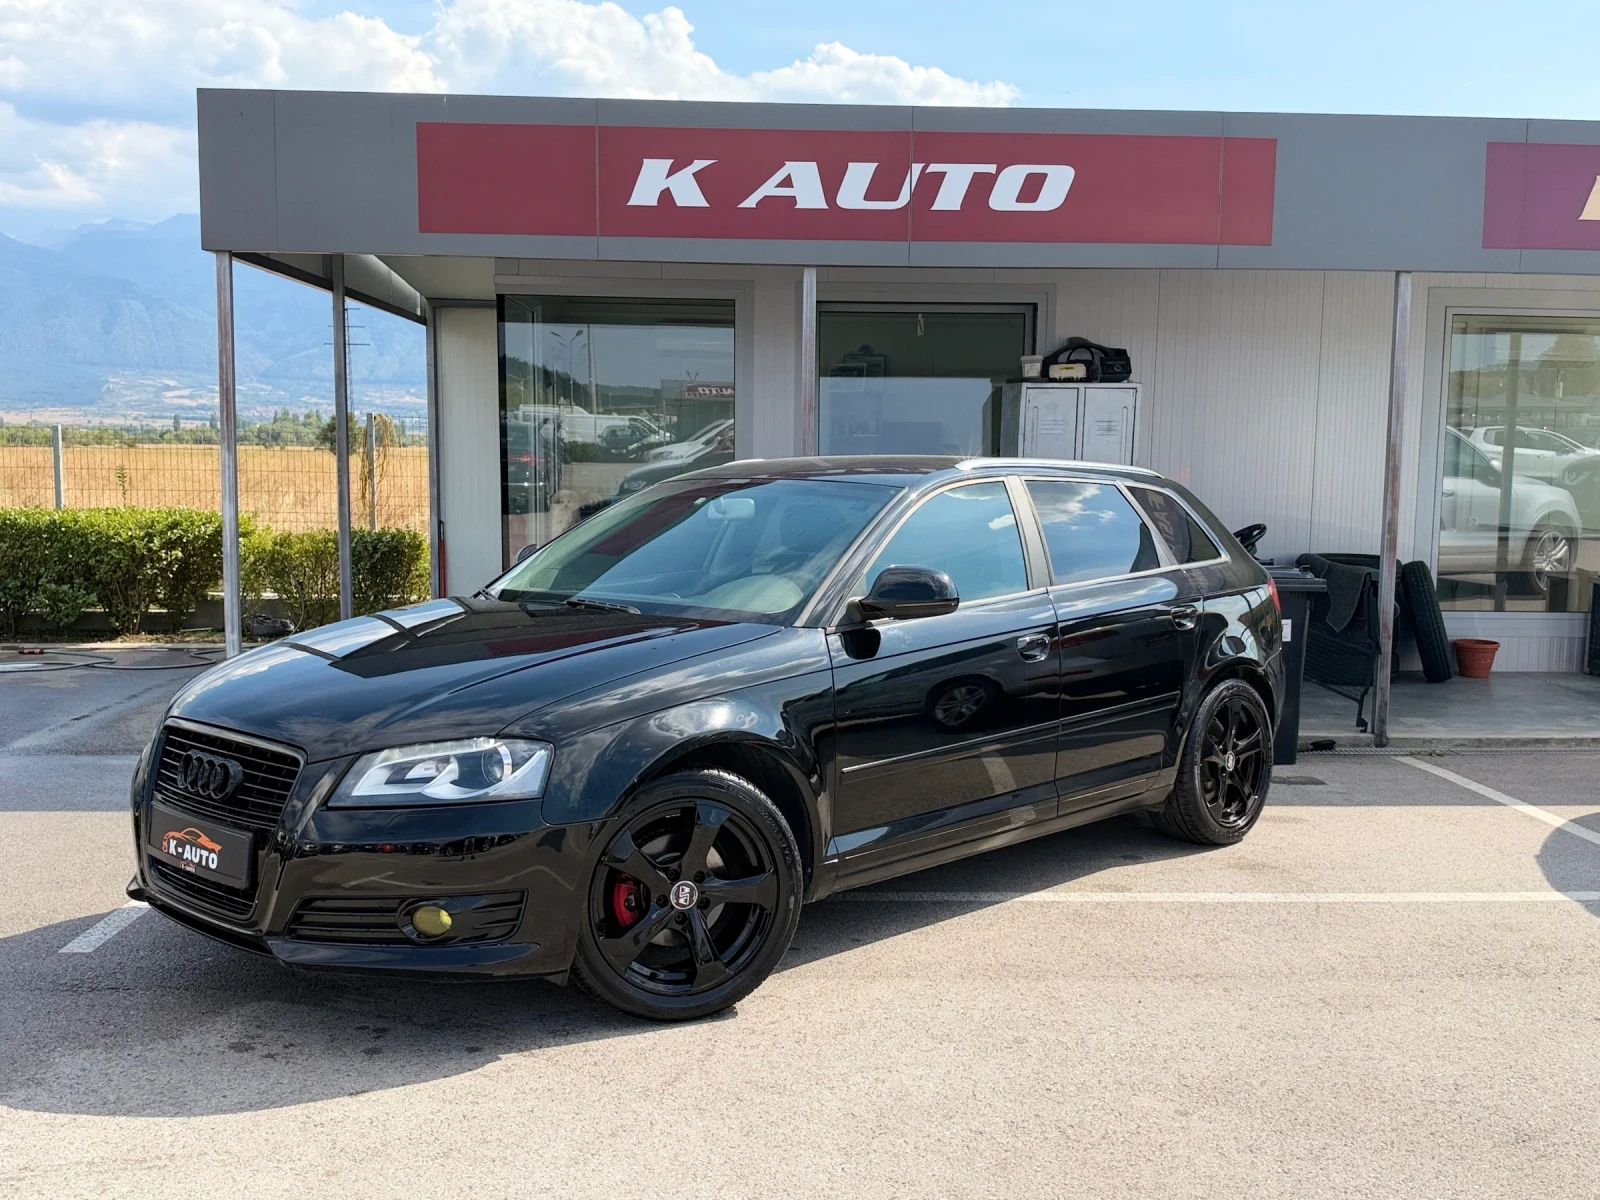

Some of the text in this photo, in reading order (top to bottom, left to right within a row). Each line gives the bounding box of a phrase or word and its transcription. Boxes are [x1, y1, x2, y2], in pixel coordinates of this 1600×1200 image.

[627, 158, 1075, 212] K AUTO
[169, 838, 218, 870] K-AUTO
